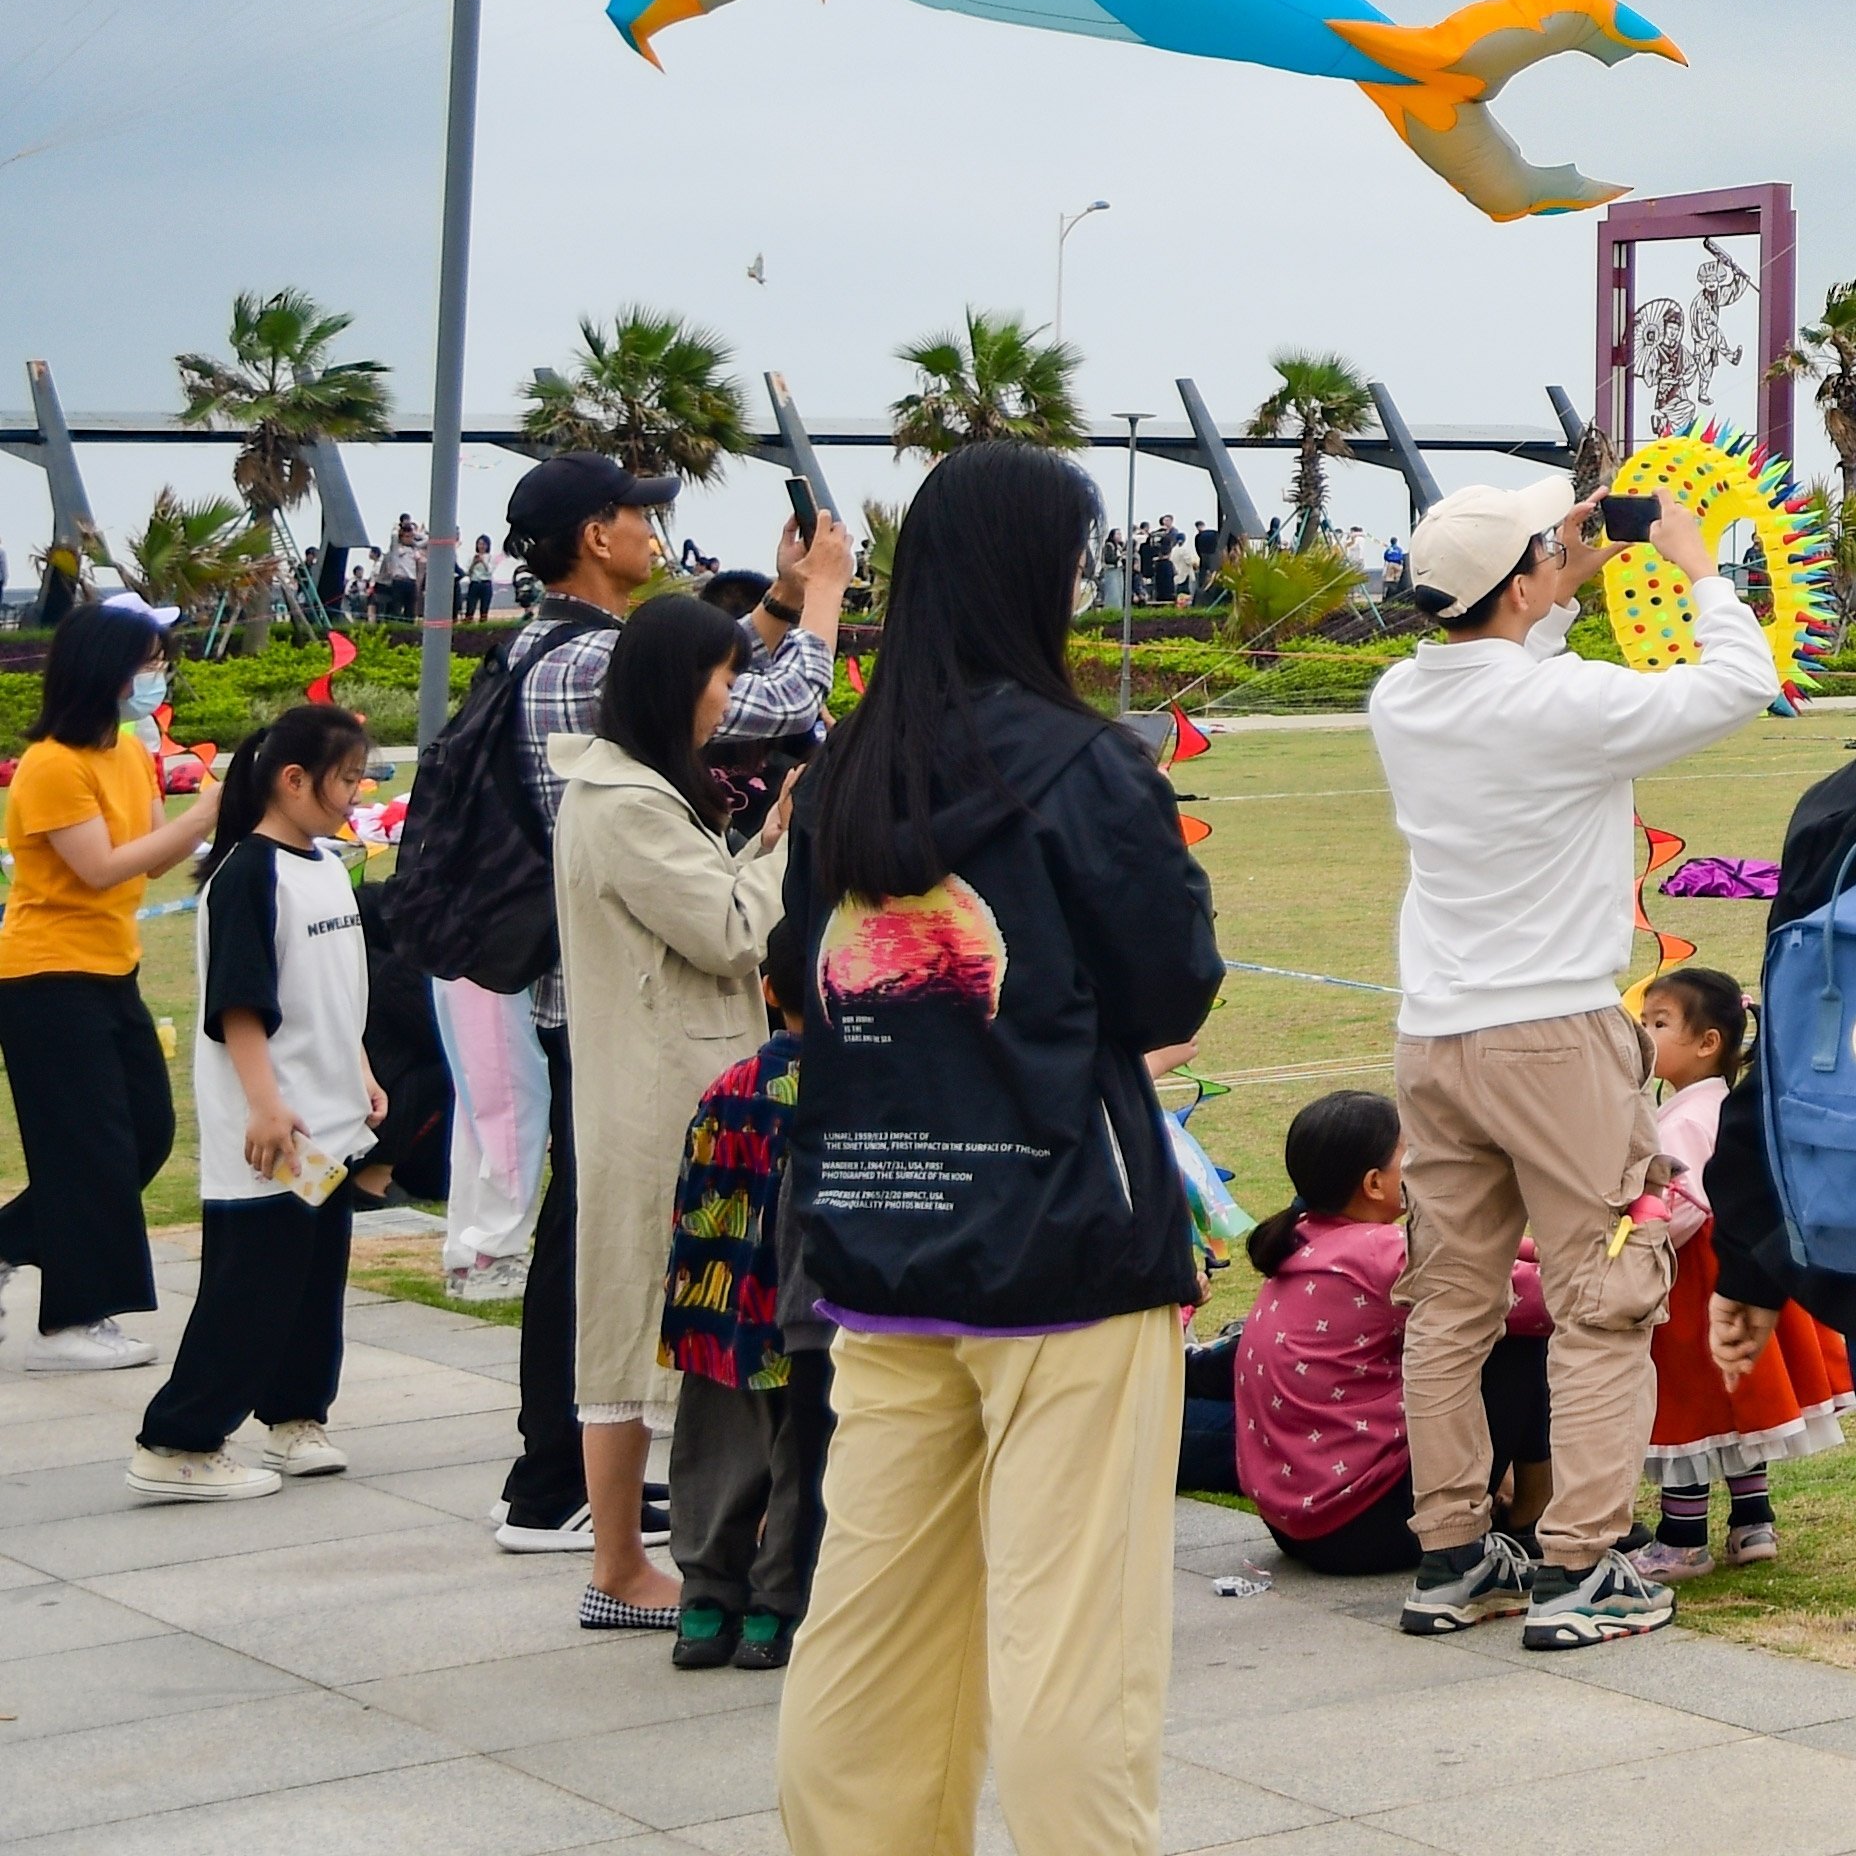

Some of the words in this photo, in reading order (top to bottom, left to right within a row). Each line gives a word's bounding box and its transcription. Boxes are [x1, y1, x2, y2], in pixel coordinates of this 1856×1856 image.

[919, 1132, 930, 1141] OF
[891, 1142, 914, 1151] FIRST
[914, 1142, 941, 1151] IMPACT
[965, 1143, 999, 1153] SURFACE
[1000, 1143, 1013, 1153] OF
[1015, 1144, 1032, 1155] THE
[925, 1161, 944, 1171] FIRST
[877, 1171, 894, 1180] THE
[896, 1171, 926, 1181] SURFACE
[927, 1172, 938, 1181] OF
